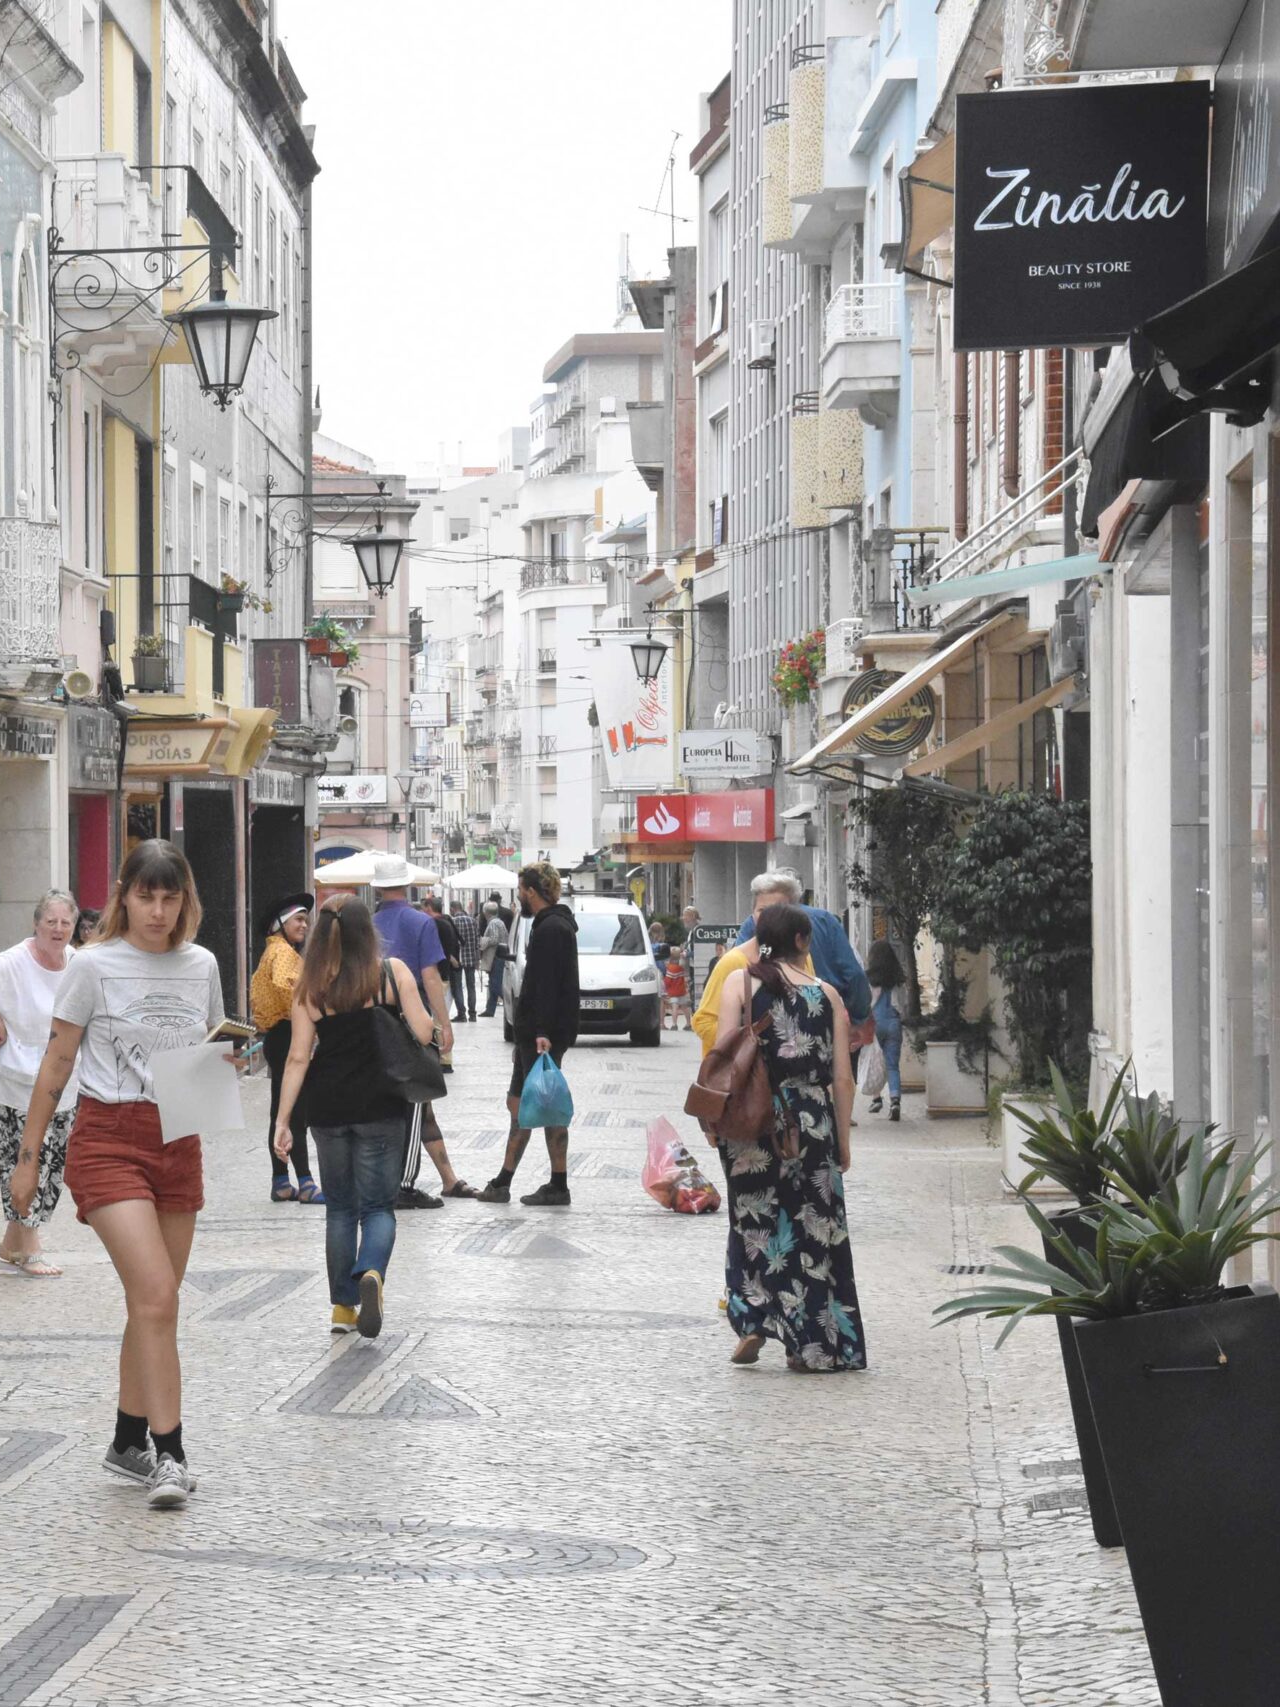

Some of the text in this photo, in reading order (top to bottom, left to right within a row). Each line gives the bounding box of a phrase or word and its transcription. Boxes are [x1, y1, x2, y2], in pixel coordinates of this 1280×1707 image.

[1028, 260, 1132, 277] BEAUTY STORE
[1058, 281, 1102, 290] SINCE 1938
[128, 734, 172, 747] OURO
[725, 740, 750, 762] HOTEL
[696, 928, 721, 940] Casa
